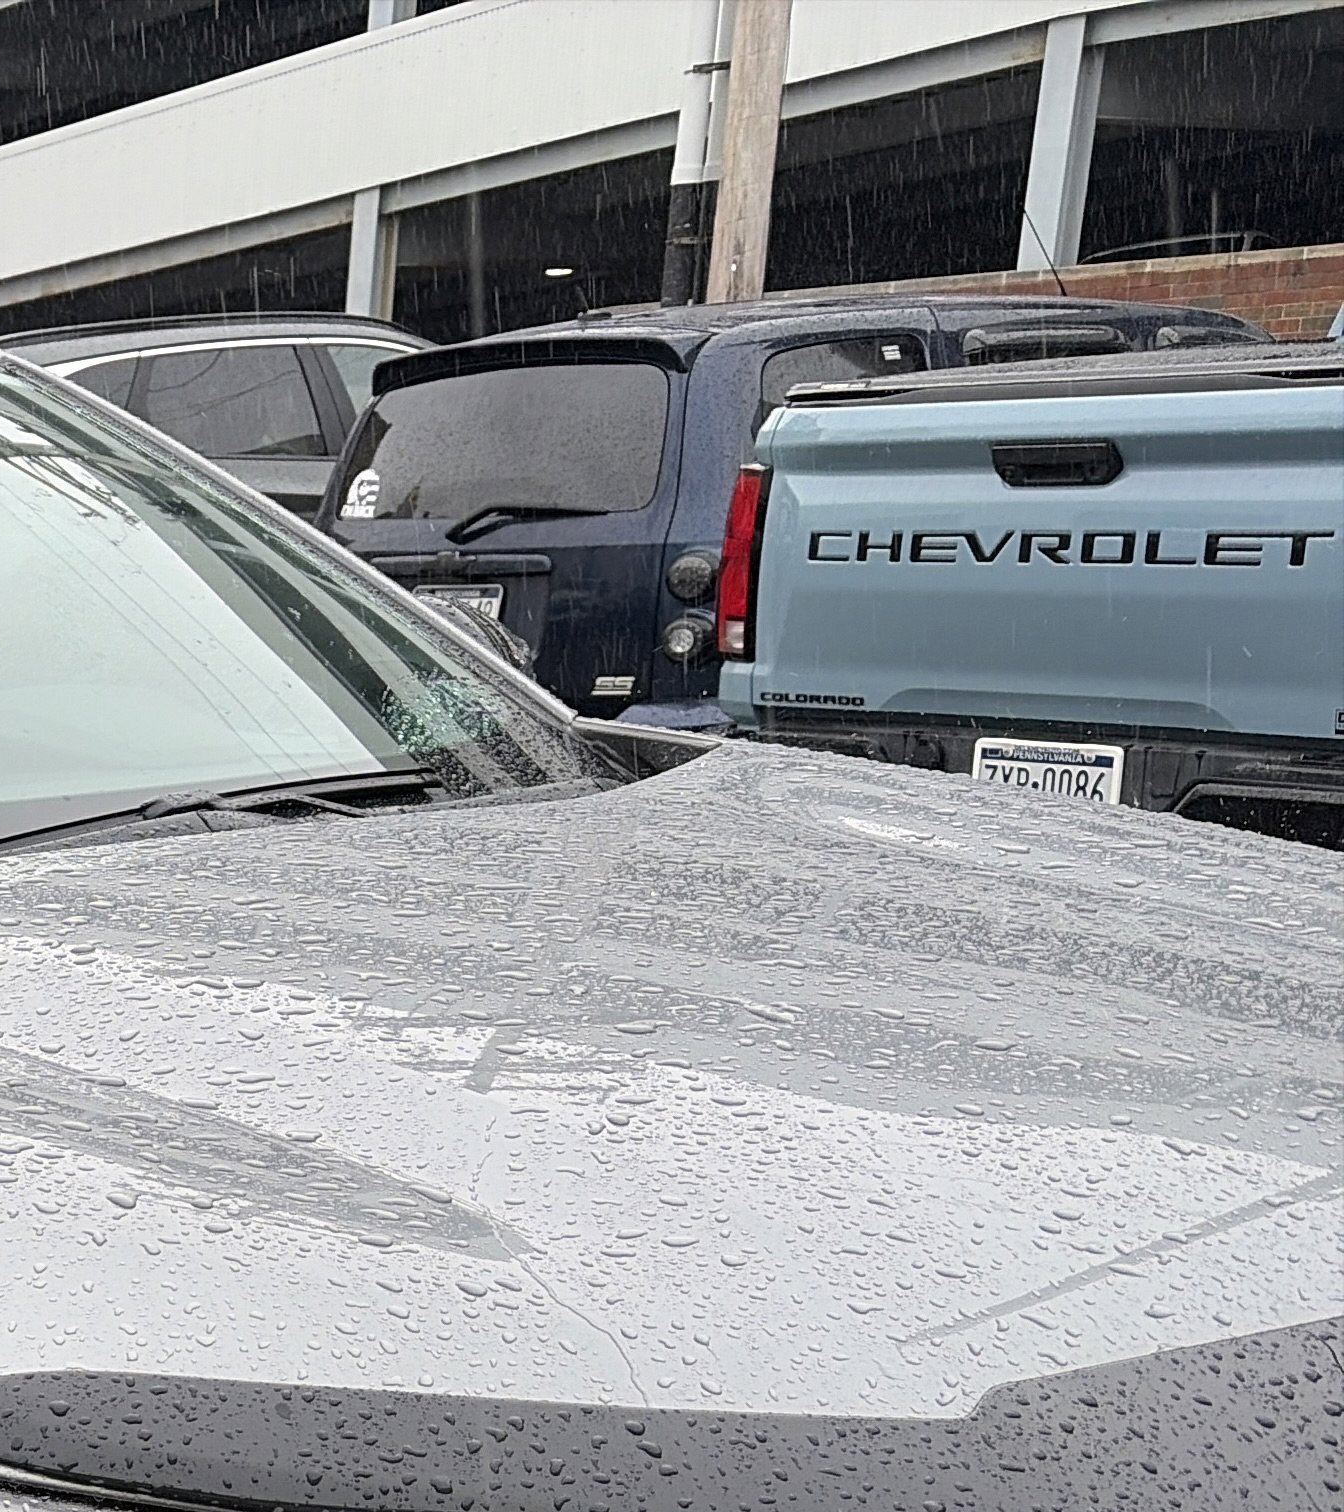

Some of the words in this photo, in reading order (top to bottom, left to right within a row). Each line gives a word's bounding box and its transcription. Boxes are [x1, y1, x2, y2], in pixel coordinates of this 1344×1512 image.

[807, 528, 1336, 567] CHEVROLET
[593, 676, 635, 691] SS
[760, 692, 865, 706] COLORADO
[1013, 749, 1083, 764] PENNSYLVANIA
